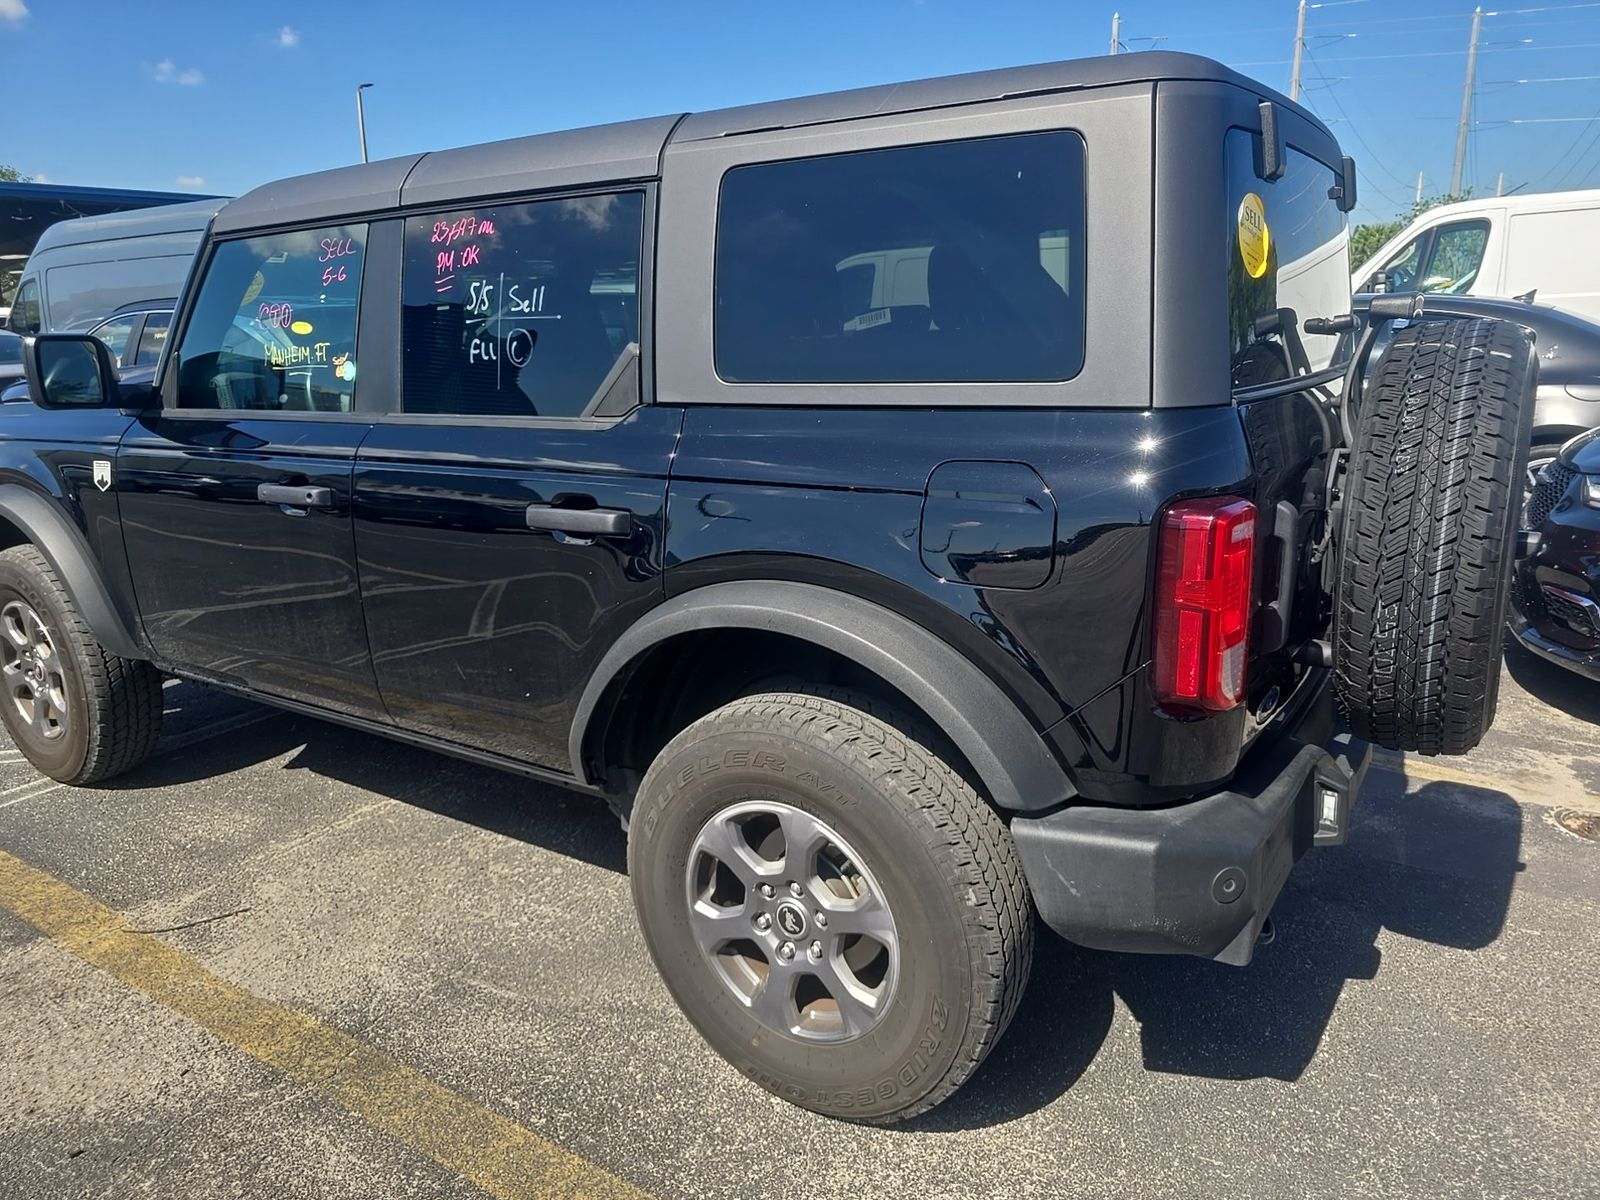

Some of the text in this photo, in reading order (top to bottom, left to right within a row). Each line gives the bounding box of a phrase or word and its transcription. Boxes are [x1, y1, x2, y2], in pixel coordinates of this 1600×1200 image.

[1244, 206, 1263, 232] SELL
[318, 237, 357, 262] SELL
[322, 265, 347, 286] 5-6
[508, 285, 545, 313] Sell
[643, 749, 786, 844] DUELER
